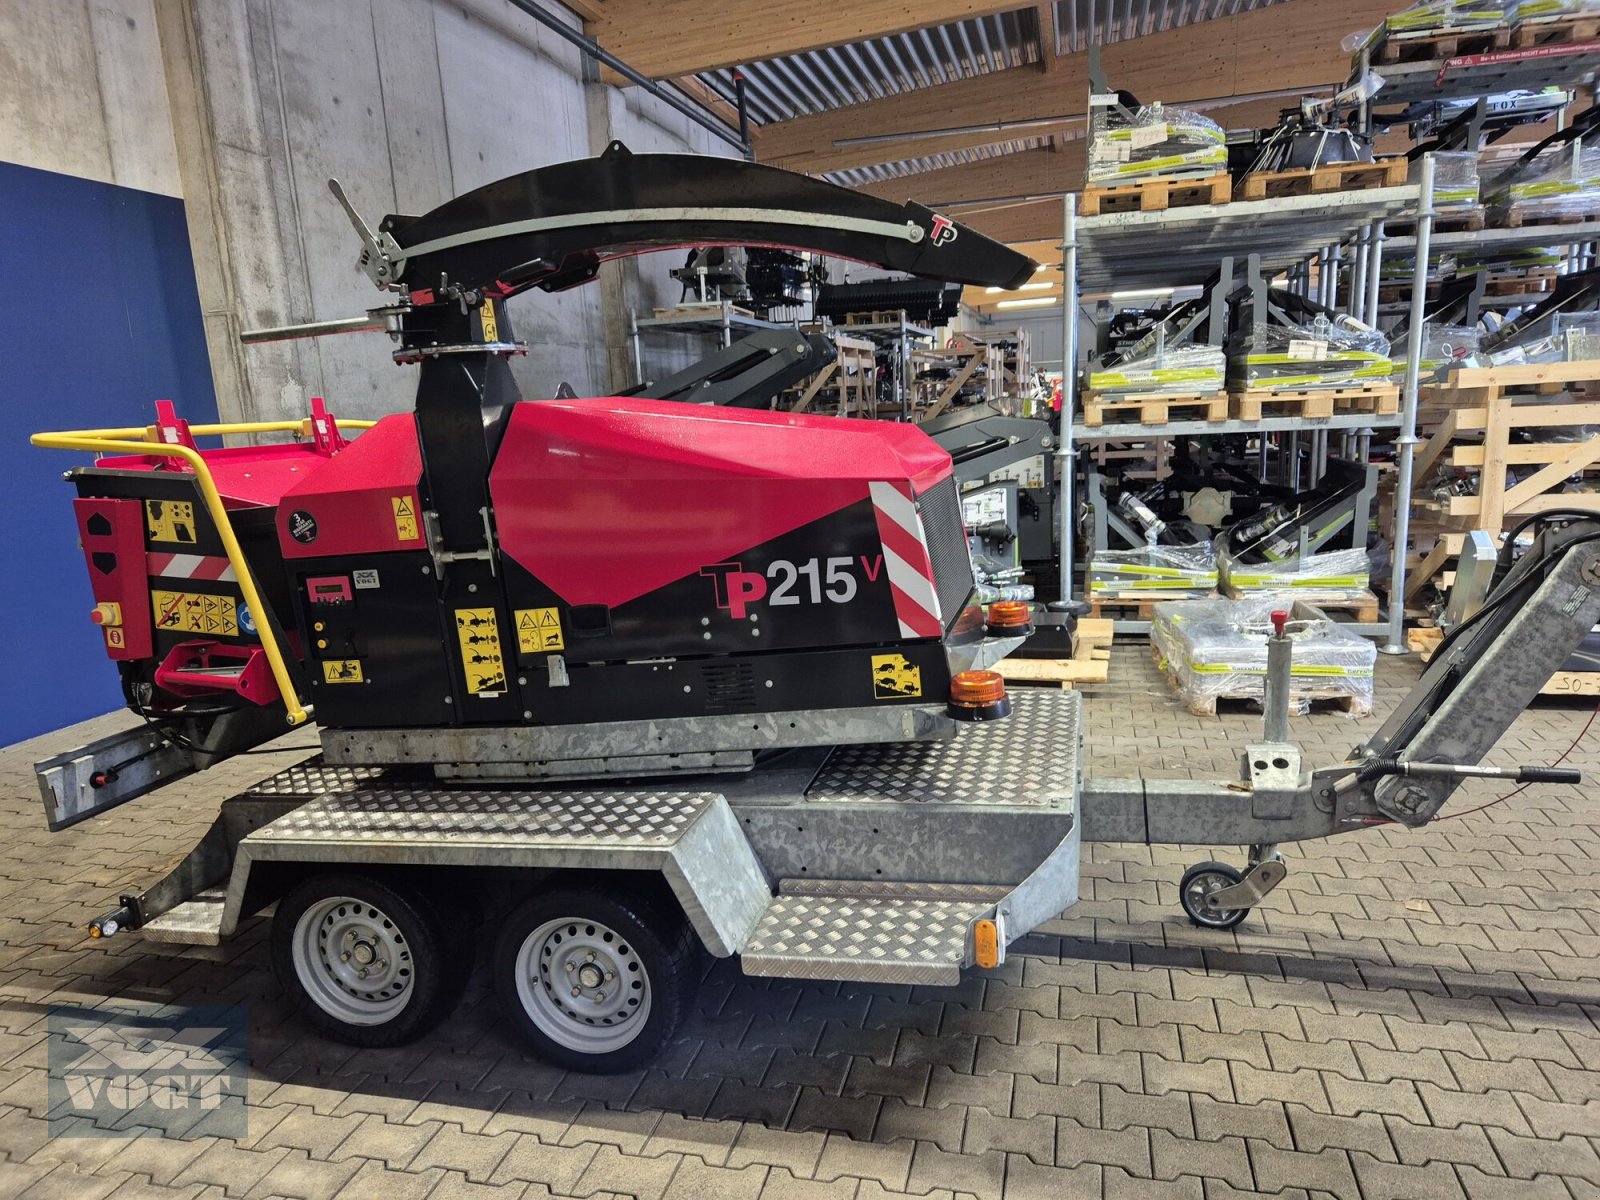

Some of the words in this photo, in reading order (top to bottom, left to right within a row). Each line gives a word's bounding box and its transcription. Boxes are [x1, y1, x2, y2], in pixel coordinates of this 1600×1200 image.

[1493, 100, 1517, 111] FOX
[931, 214, 958, 247] TP
[293, 513, 301, 522] 3
[766, 556, 858, 606] 215
